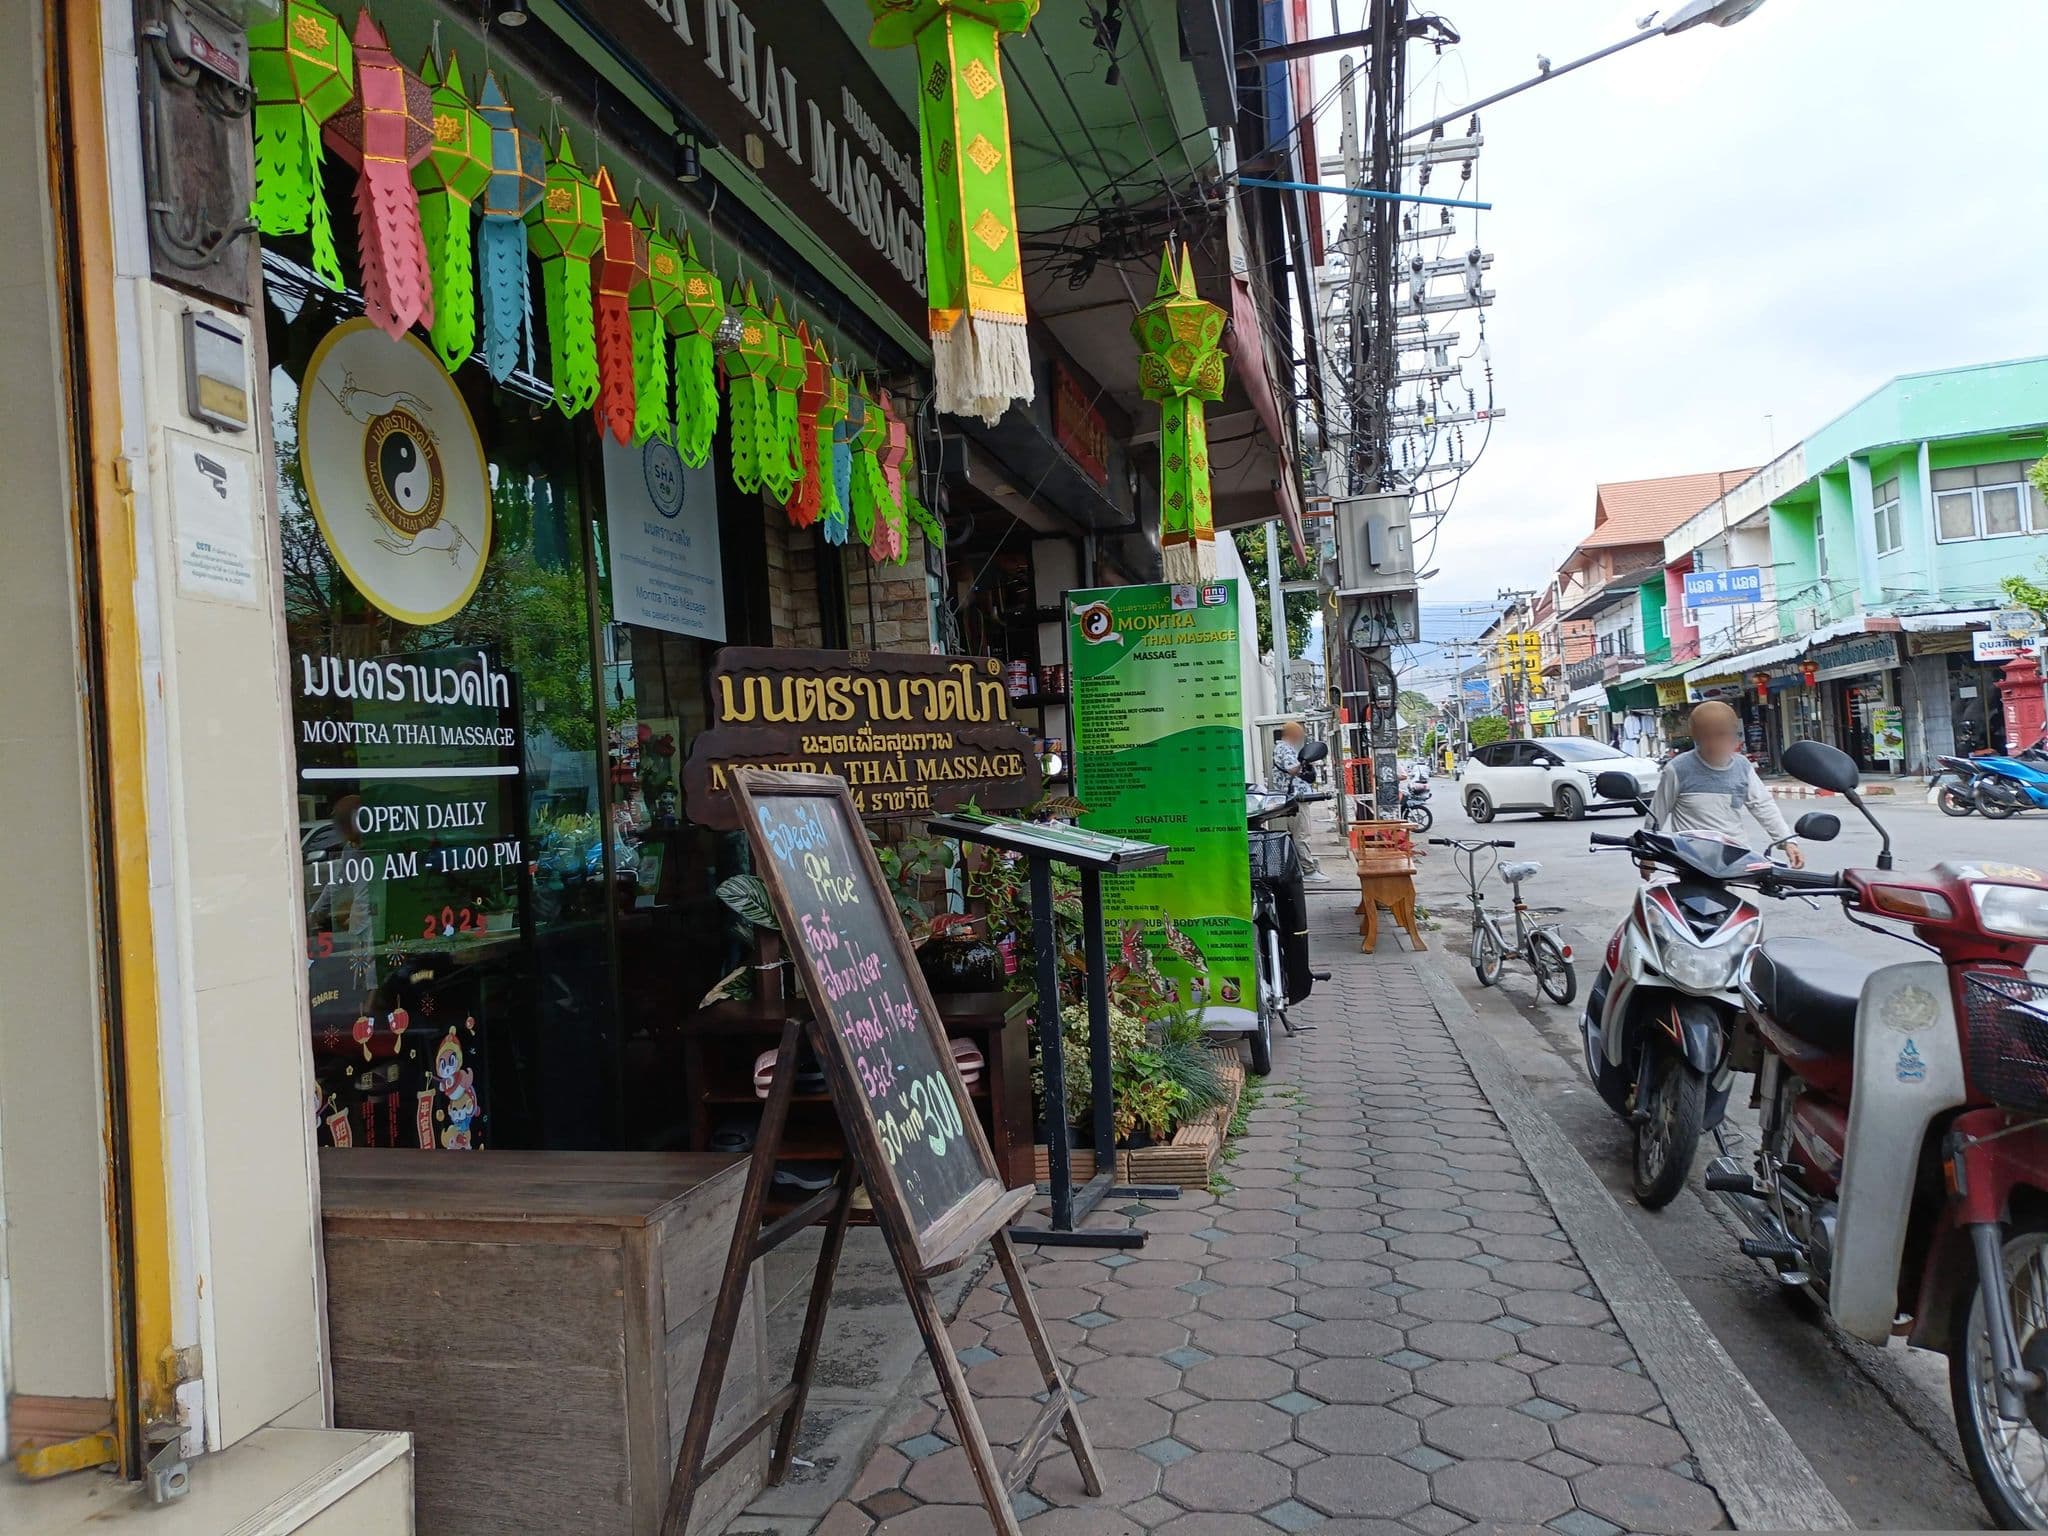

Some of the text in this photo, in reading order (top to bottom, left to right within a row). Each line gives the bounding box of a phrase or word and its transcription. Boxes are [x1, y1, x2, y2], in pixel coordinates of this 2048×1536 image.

[807, 99, 928, 299] MASSAGE
[369, 460, 397, 520] MONTRA
[655, 465, 676, 486] SHA
[1118, 612, 1197, 632] MONTRA
[1142, 629, 1237, 647] THAI MASSAGE
[1133, 650, 1178, 661] MASSAGE
[302, 651, 510, 708] มนตรานวดไท
[303, 720, 516, 747] MONTRA THAI MASSAGE
[844, 757, 909, 786] THAI
[916, 753, 1024, 783] MASSAGE
[356, 801, 487, 834] OPEN DAILY
[1135, 814, 1188, 824] SIGNATURE
[312, 856, 375, 887] 11.00
[382, 851, 419, 880] AM
[440, 846, 489, 873] 11.00
[493, 841, 523, 867] PM
[424, 905, 489, 940] 2025
[1173, 918, 1200, 927] BODY
[1202, 918, 1231, 927] MASK
[311, 989, 340, 1008] SNAKE
[910, 1070, 964, 1157] 300
